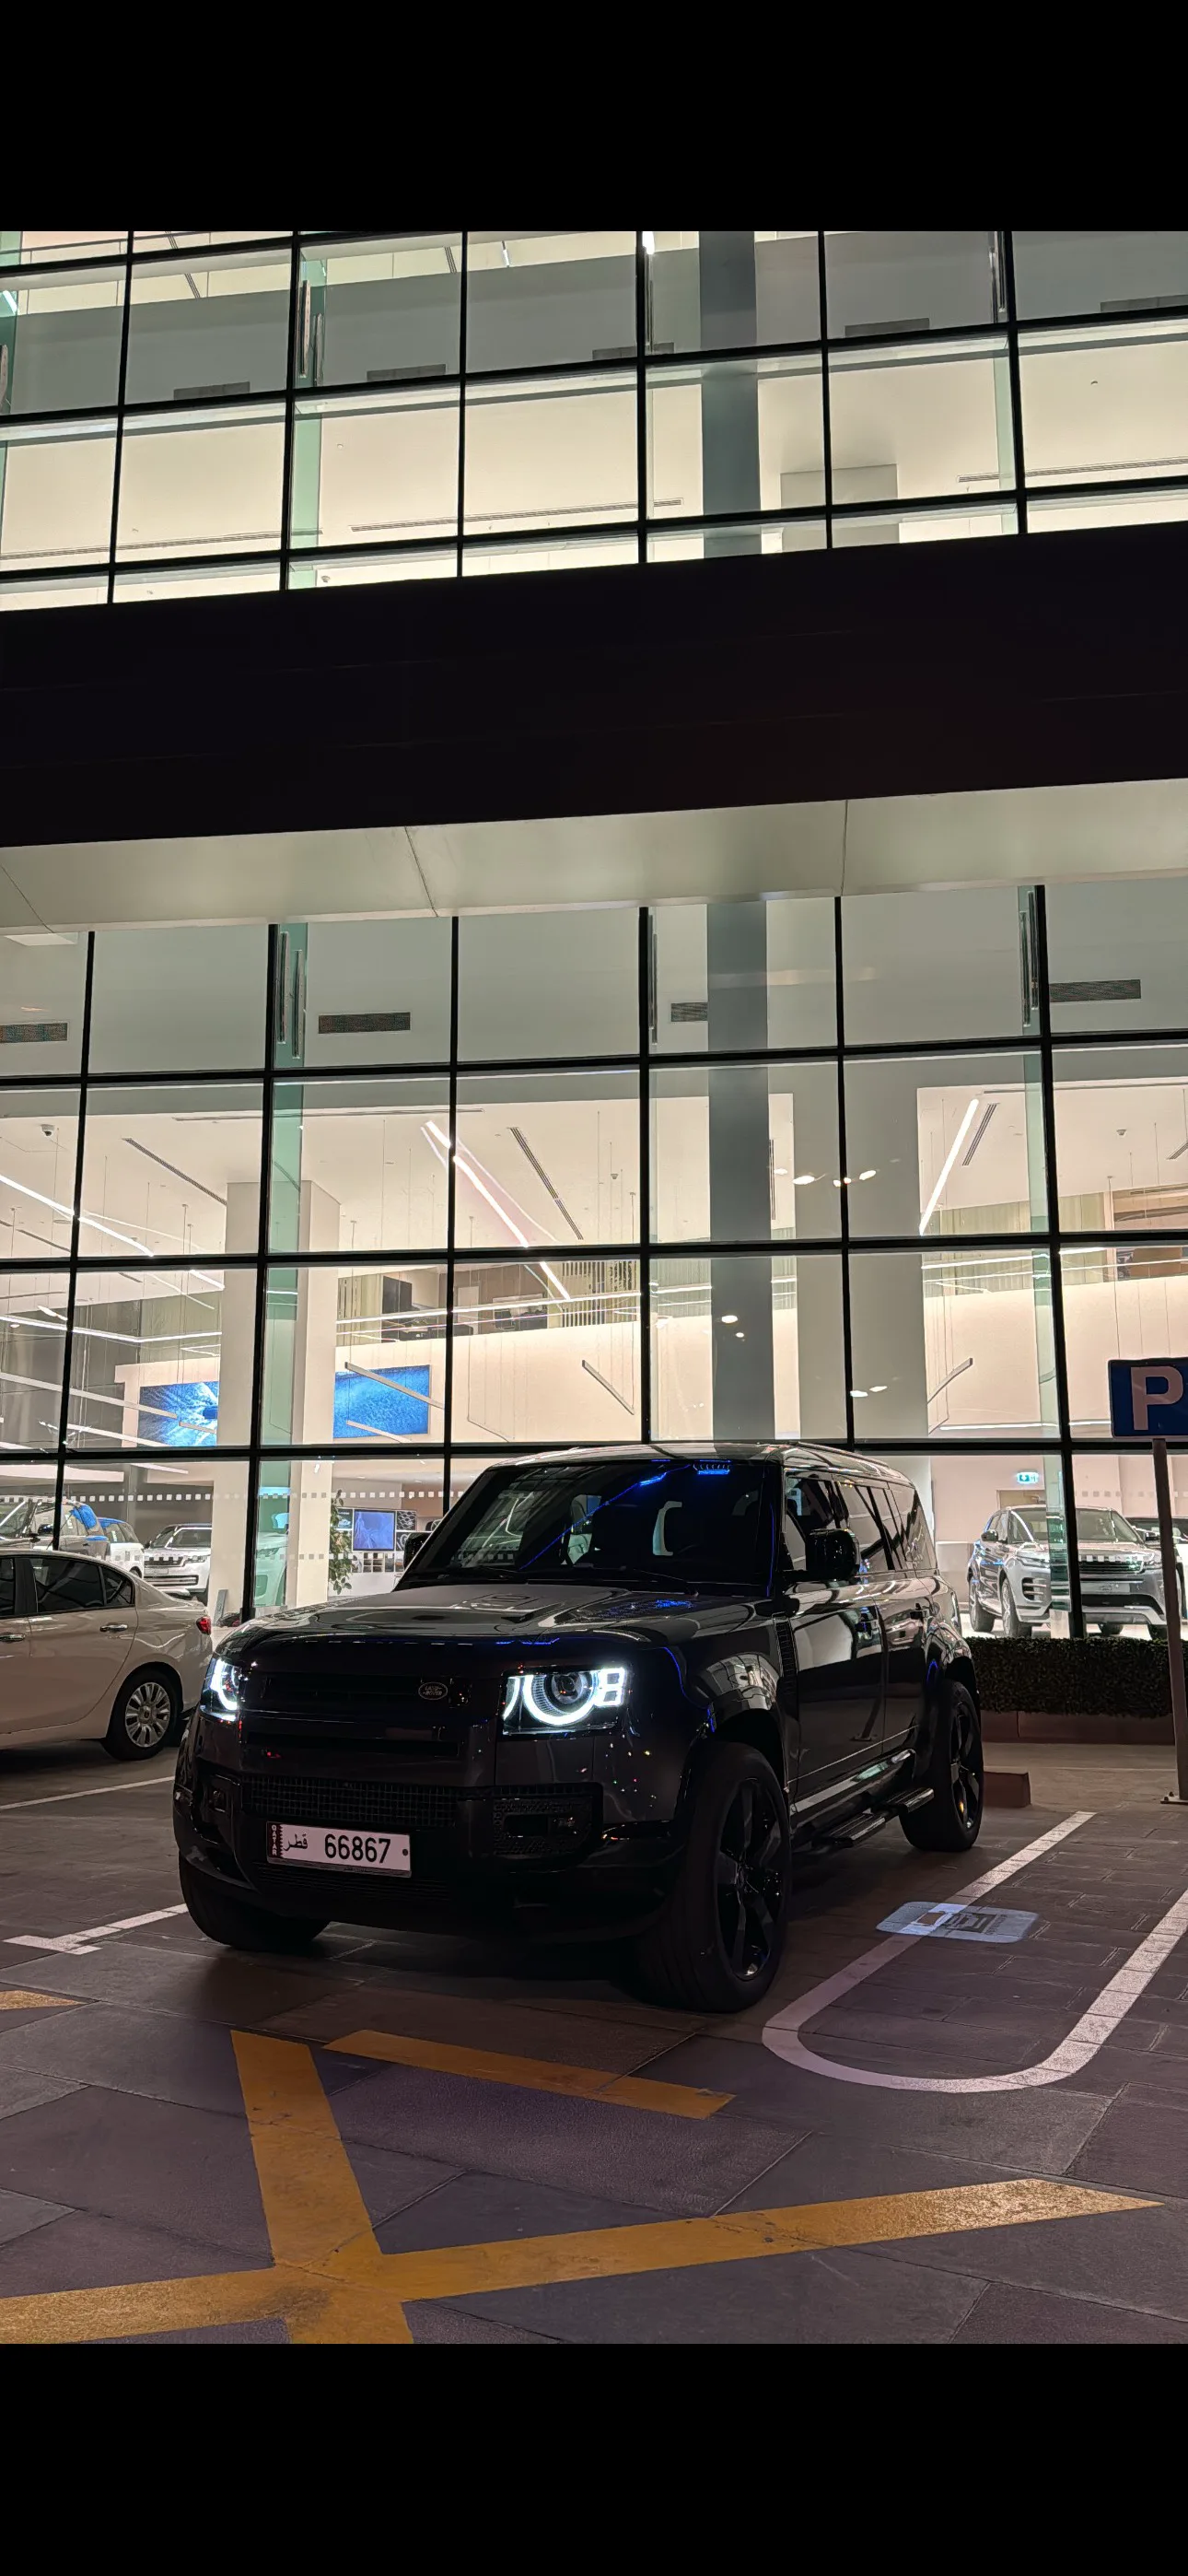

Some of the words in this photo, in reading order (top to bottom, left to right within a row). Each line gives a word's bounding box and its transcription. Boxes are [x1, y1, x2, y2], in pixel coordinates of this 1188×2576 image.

[1130, 1365, 1184, 1431] P
[283, 1833, 309, 1851] قطر
[324, 1833, 390, 1863] 66867
